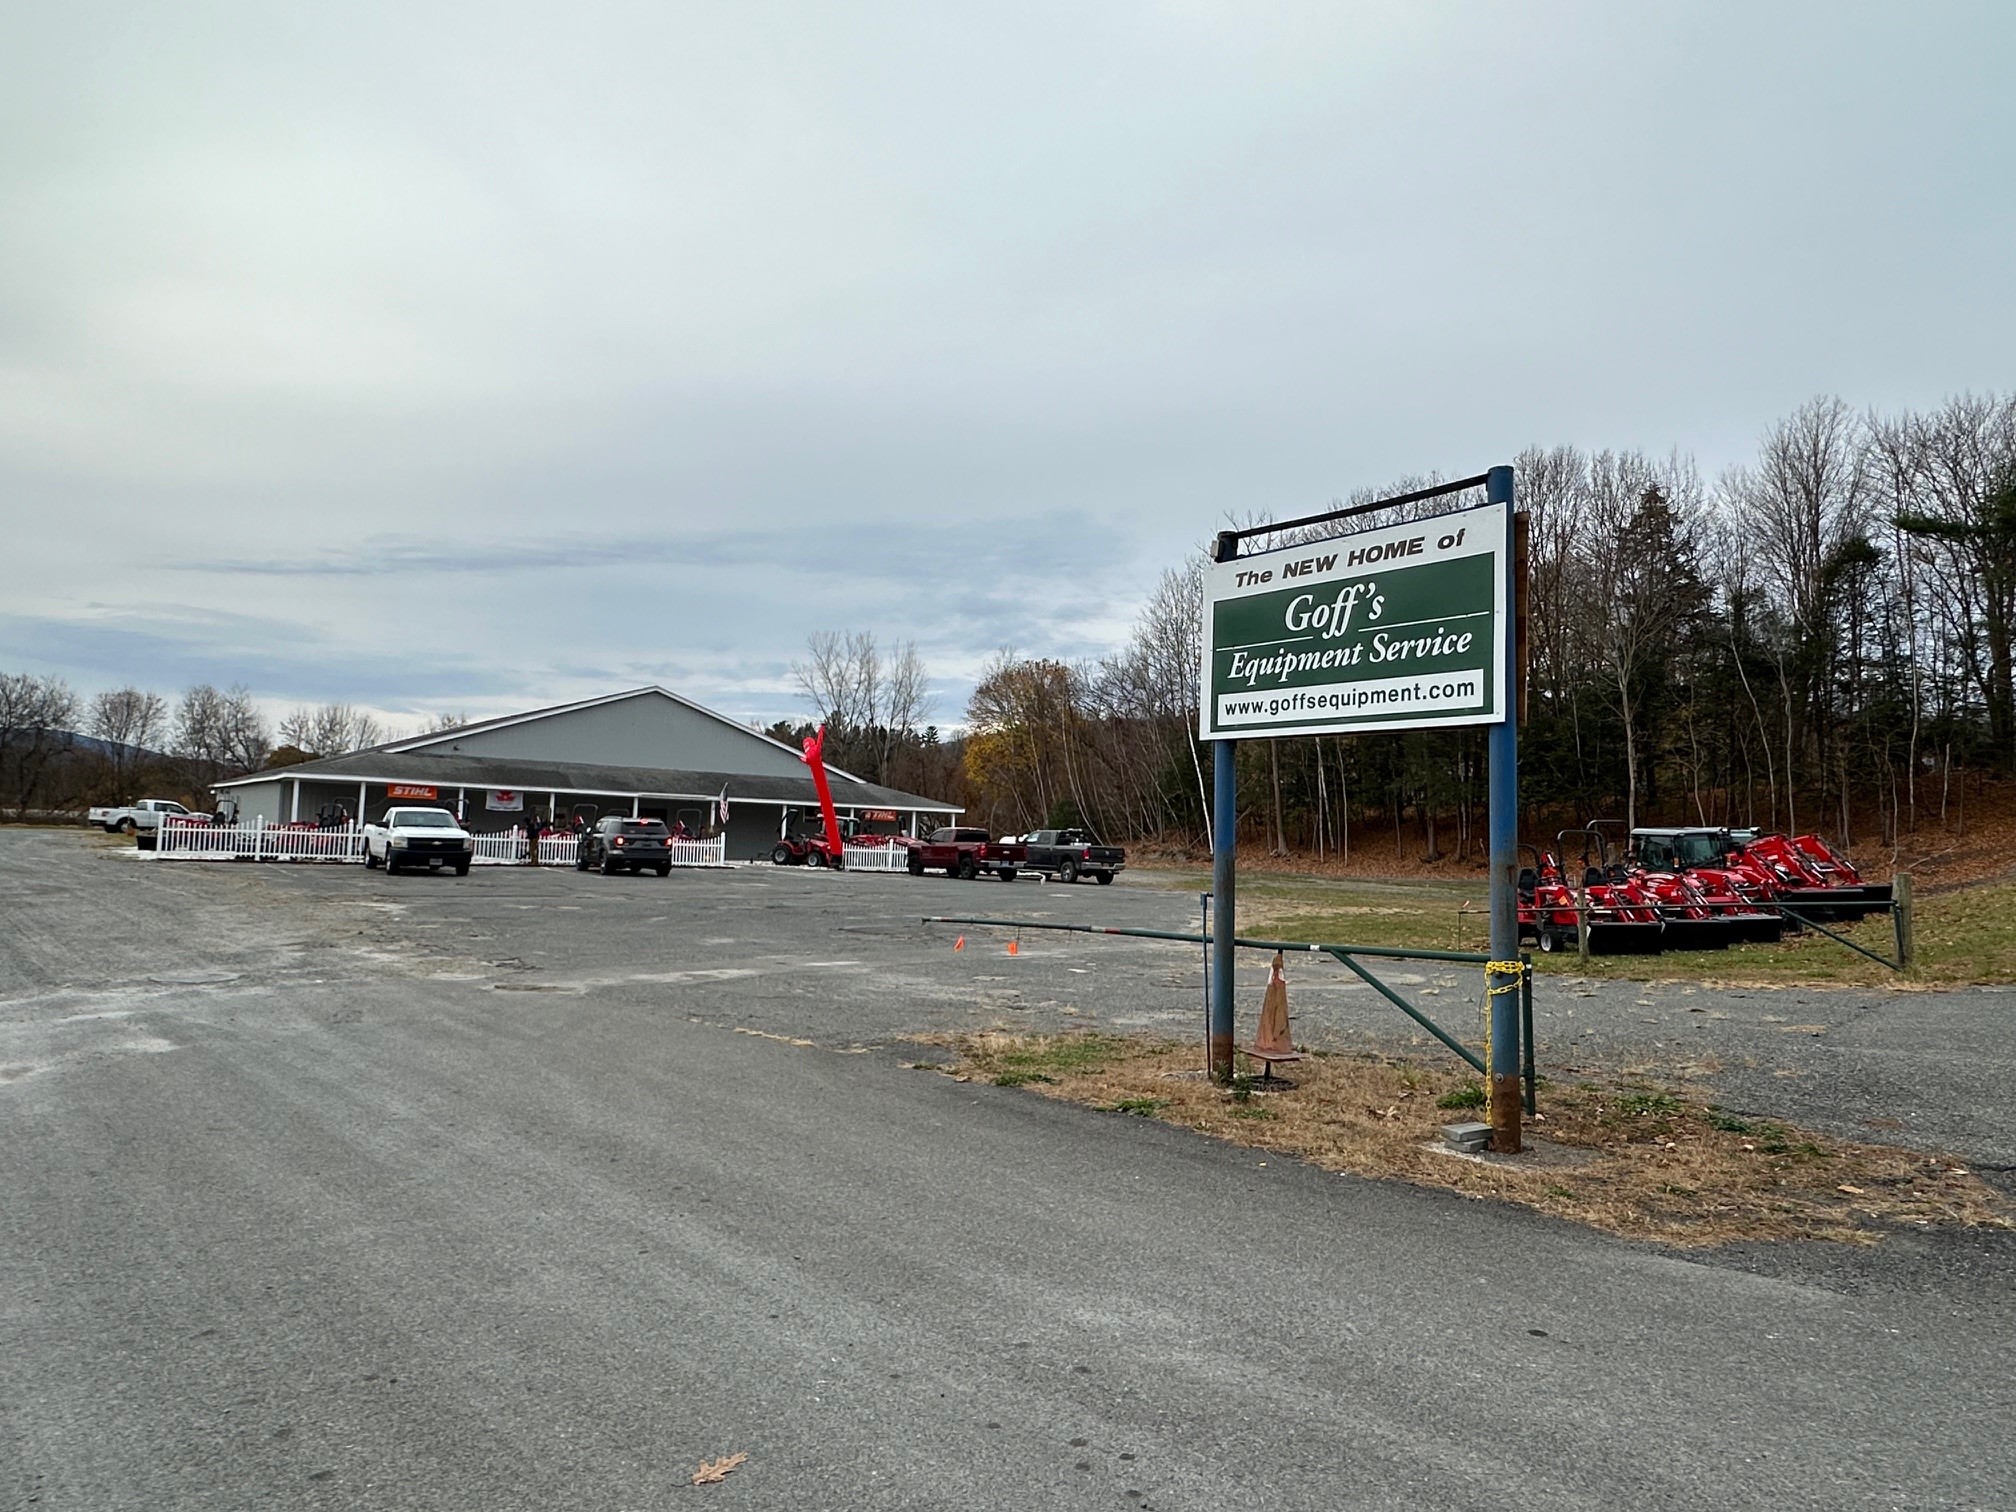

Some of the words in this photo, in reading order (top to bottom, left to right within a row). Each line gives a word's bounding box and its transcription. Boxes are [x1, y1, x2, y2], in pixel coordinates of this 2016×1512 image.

[1236, 570, 1273, 587] The
[1283, 554, 1337, 579] NEW
[1347, 537, 1425, 567] HOME
[1437, 528, 1466, 549] of
[1285, 582, 1385, 639] Goff's
[1227, 644, 1363, 686] Equipment
[1369, 627, 1473, 663] Service
[1225, 681, 1475, 715] www.goffsequipment.com
[393, 786, 432, 796] STIHL
